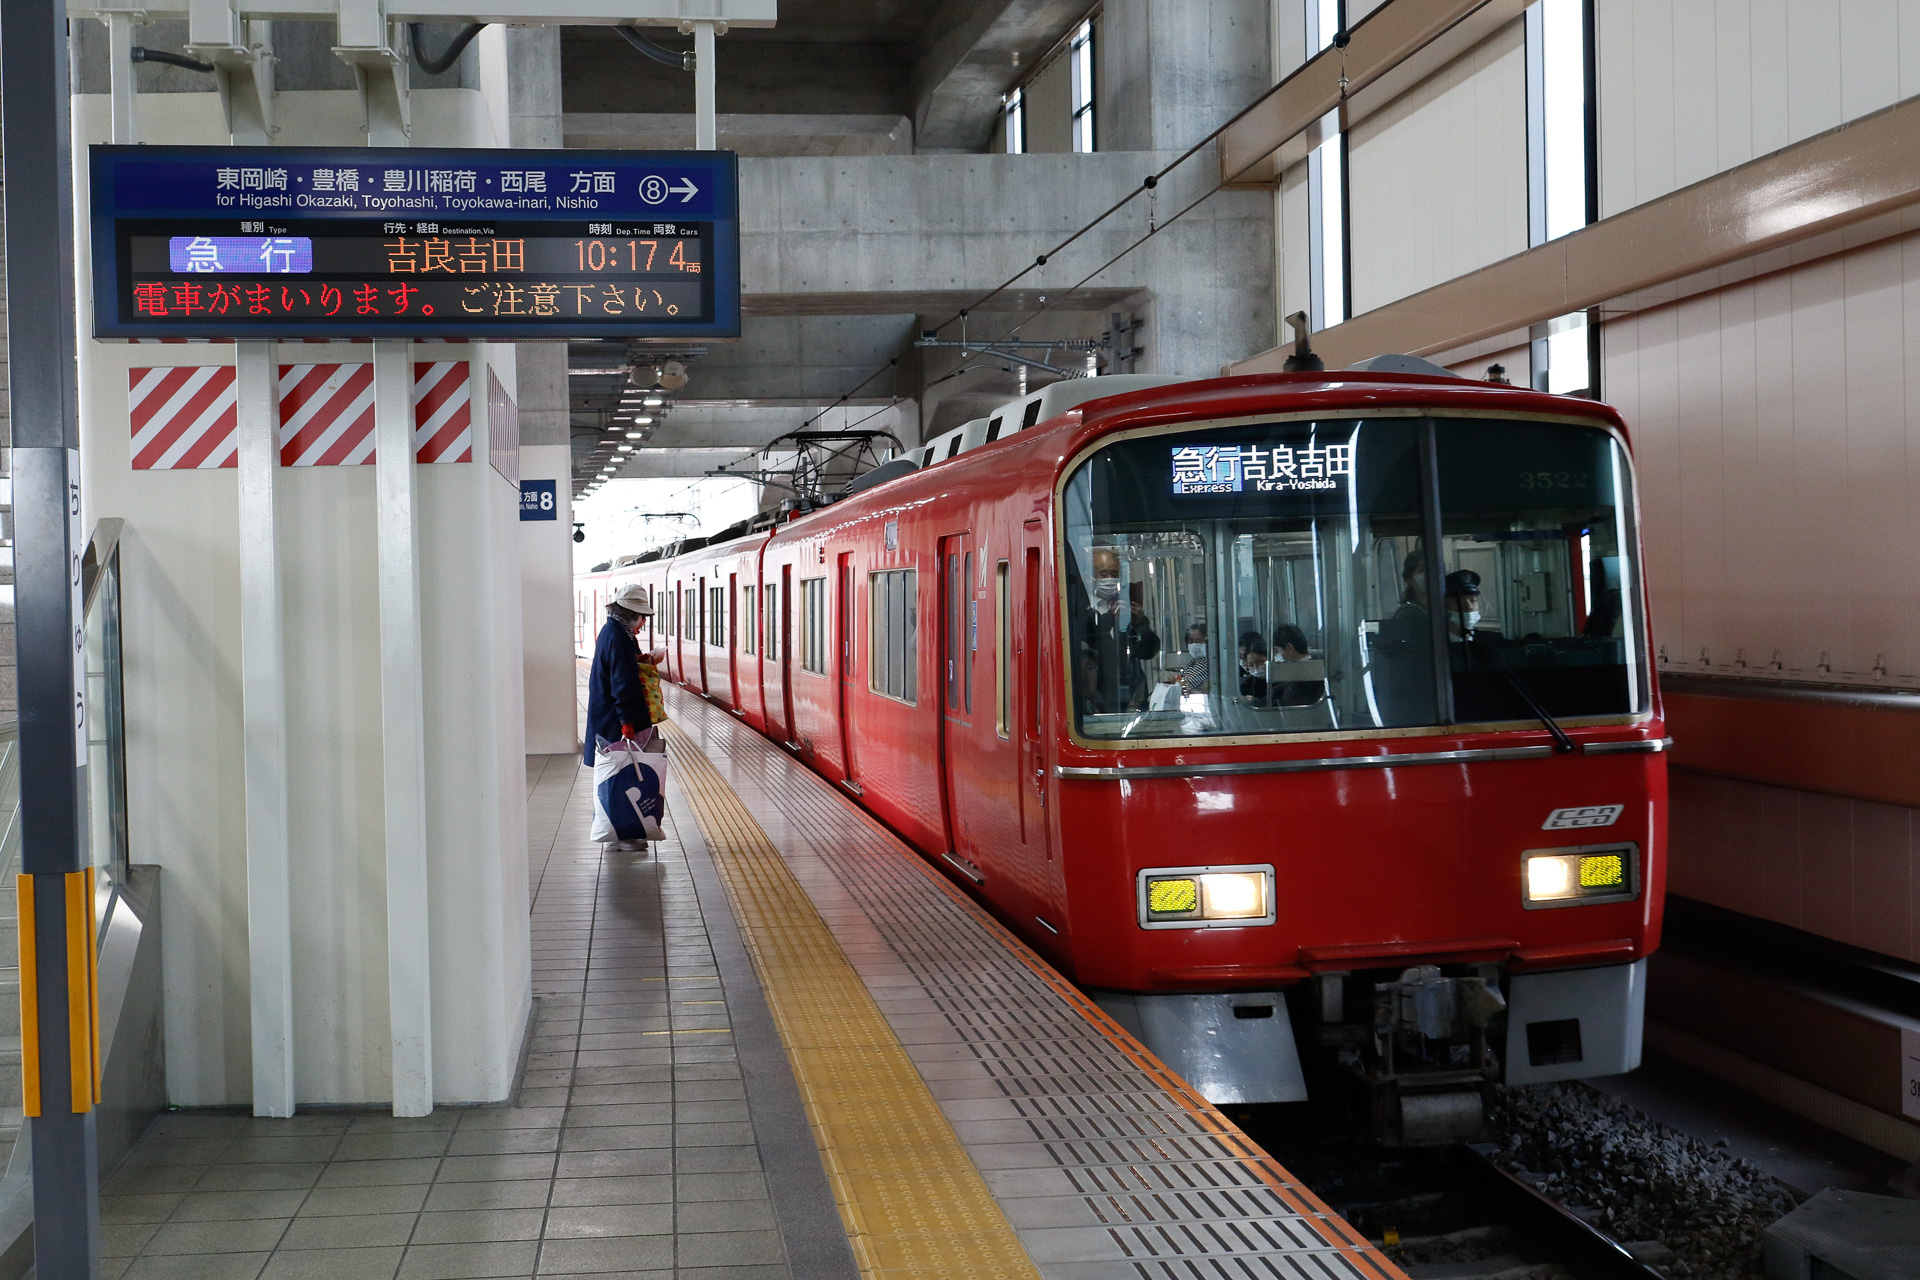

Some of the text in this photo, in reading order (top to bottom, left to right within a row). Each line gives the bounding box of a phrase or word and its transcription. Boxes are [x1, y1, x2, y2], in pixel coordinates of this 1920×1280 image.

[569, 171, 615, 194] 方面
[216, 193, 599, 211] for Higashi Okazaki, Toyohashi, Toyokawa-inari, Nishio
[240, 221, 287, 234] 種別 Type
[383, 222, 439, 235] 行先・経由
[588, 223, 612, 235] 時刻
[653, 223, 676, 235] 両数
[383, 236, 525, 274] 吉良吉田
[575, 240, 657, 271] 10:17
[133, 281, 679, 316] 電車がまいります。 ご注意下さい。
[1172, 444, 1351, 483] 急行 吉良吉田
[1181, 482, 1233, 494] Express
[1256, 477, 1337, 492] Kira-Yoshida
[540, 491, 553, 511] 8
